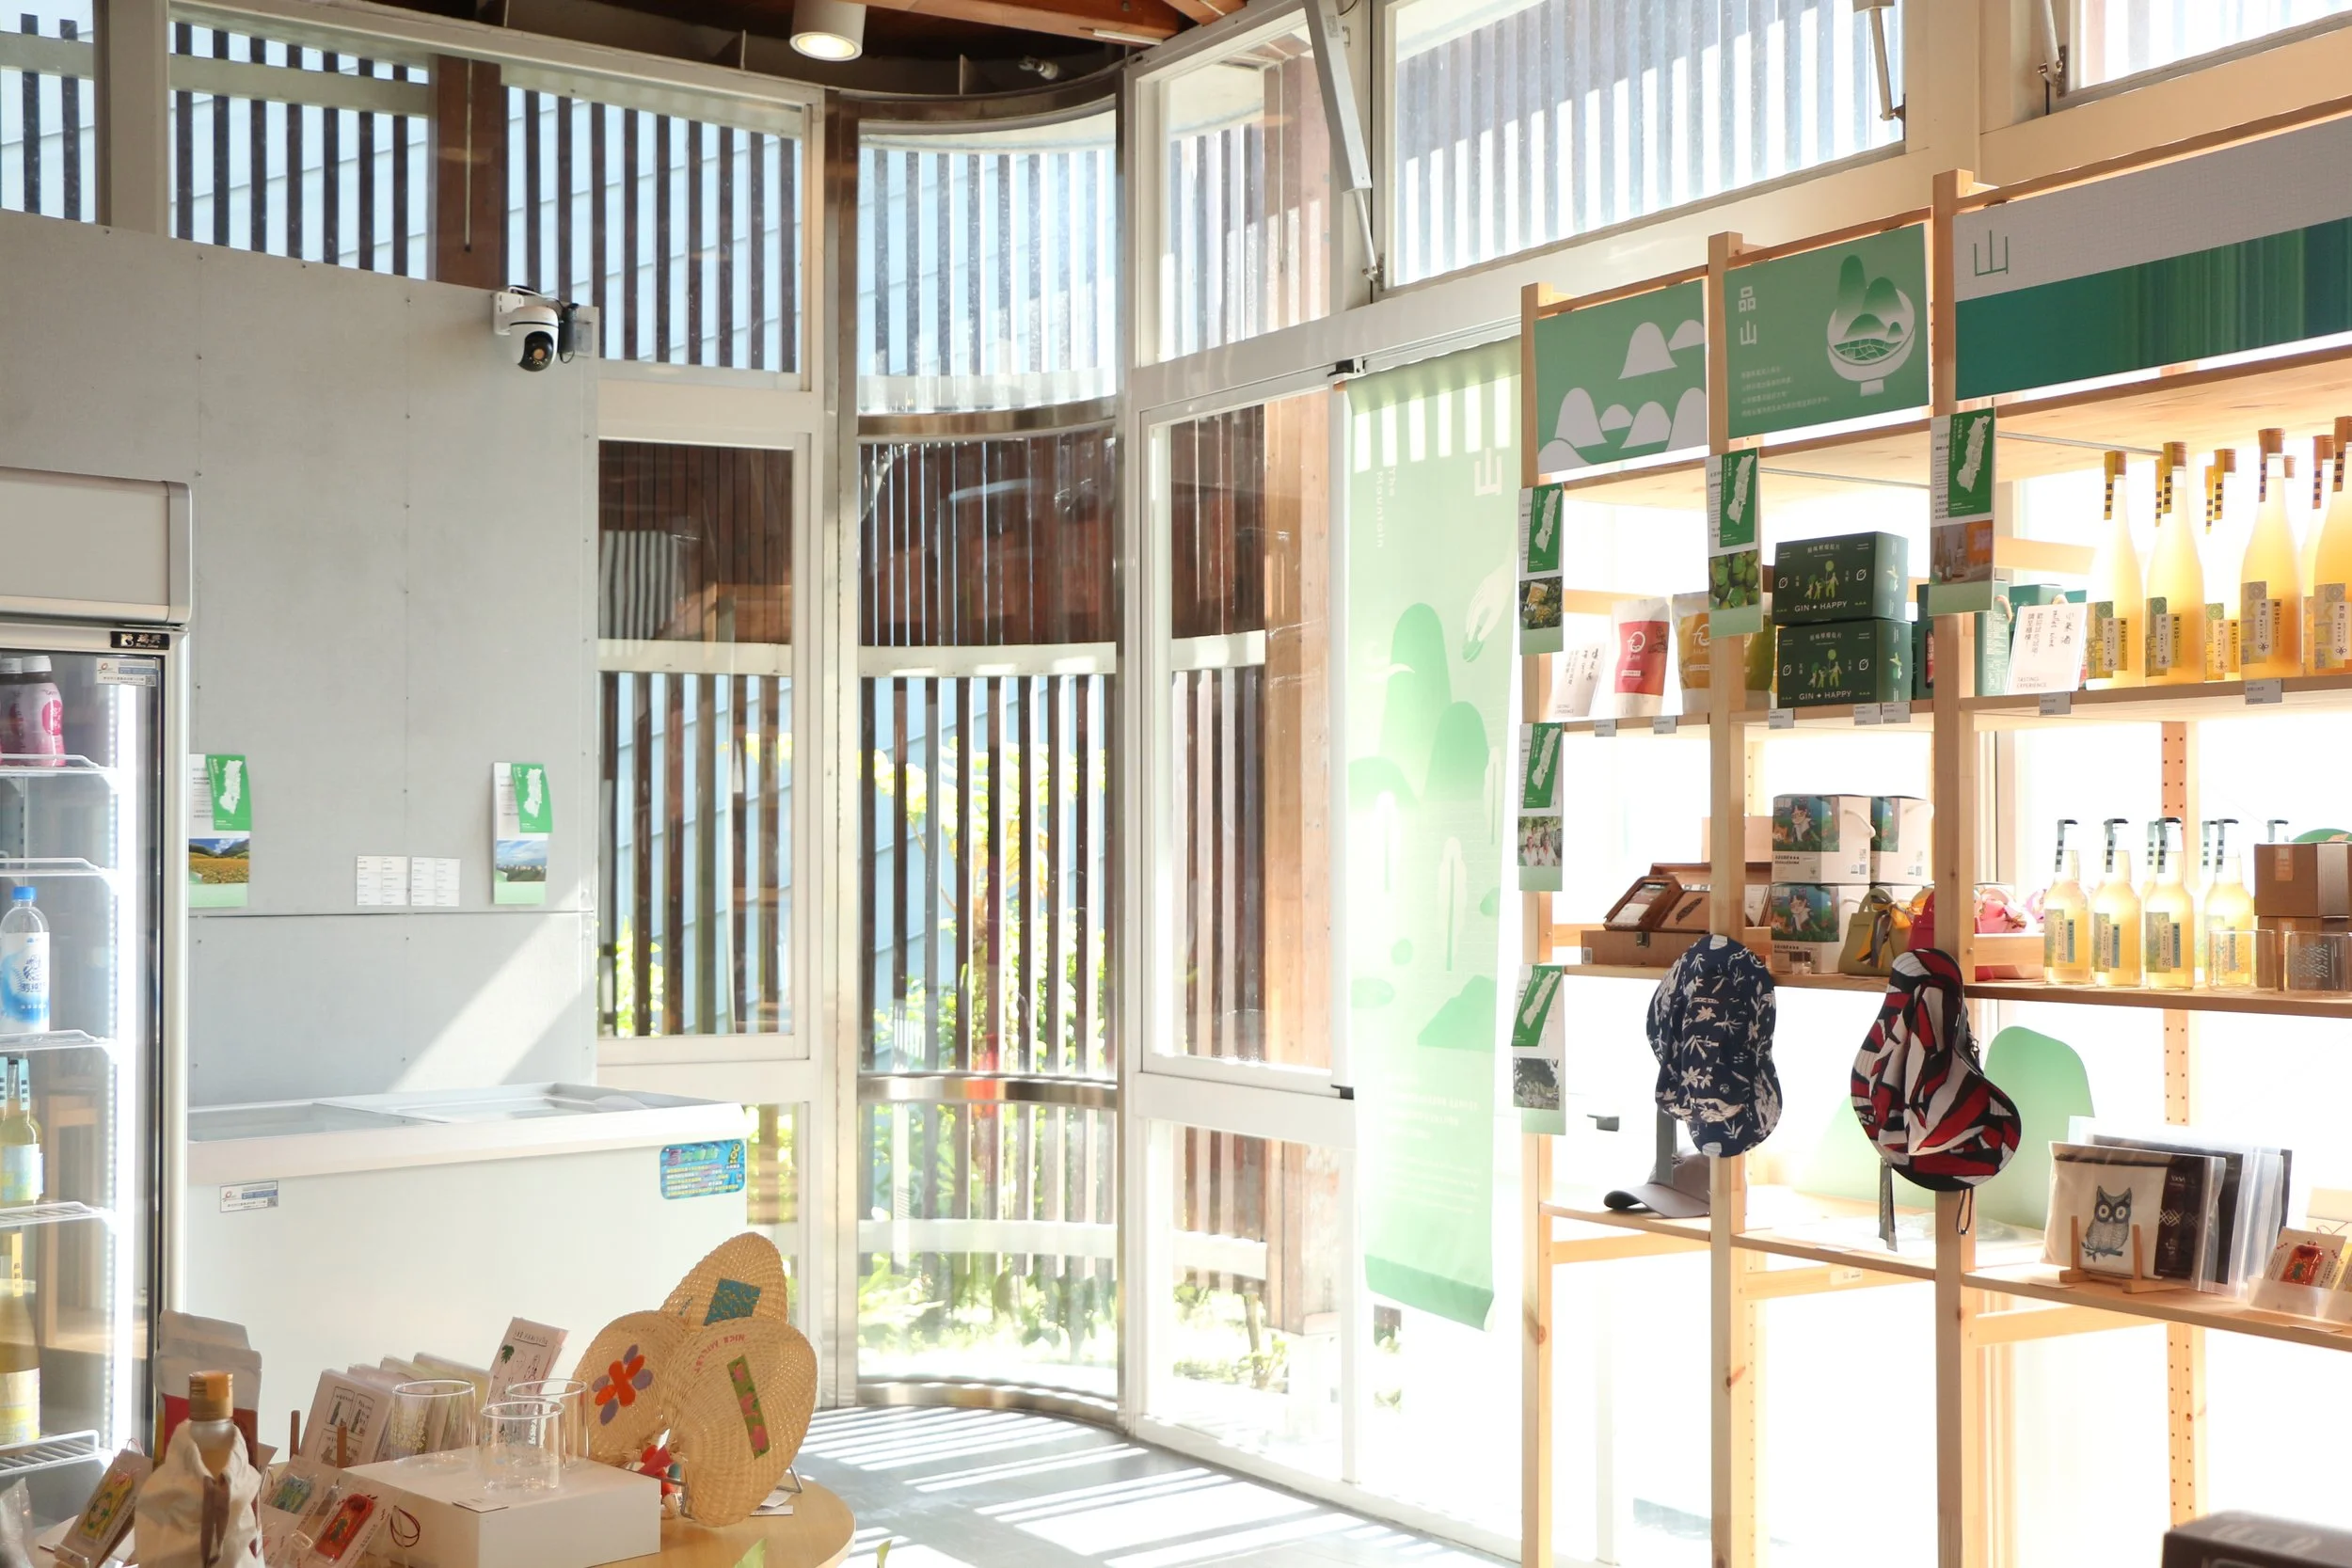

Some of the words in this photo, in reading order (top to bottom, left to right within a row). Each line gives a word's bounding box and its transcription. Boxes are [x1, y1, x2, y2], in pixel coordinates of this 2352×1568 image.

[1973, 230, 2010, 277] 山
[1738, 285, 1757, 346] 品山
[1474, 447, 1502, 497] 山
[1376, 470, 1385, 548] Mountain
[1794, 604, 1810, 612] GIN
[1820, 600, 1848, 610] HAPPY
[1799, 692, 1814, 701] GIN
[1824, 690, 1851, 699] HAPPY
